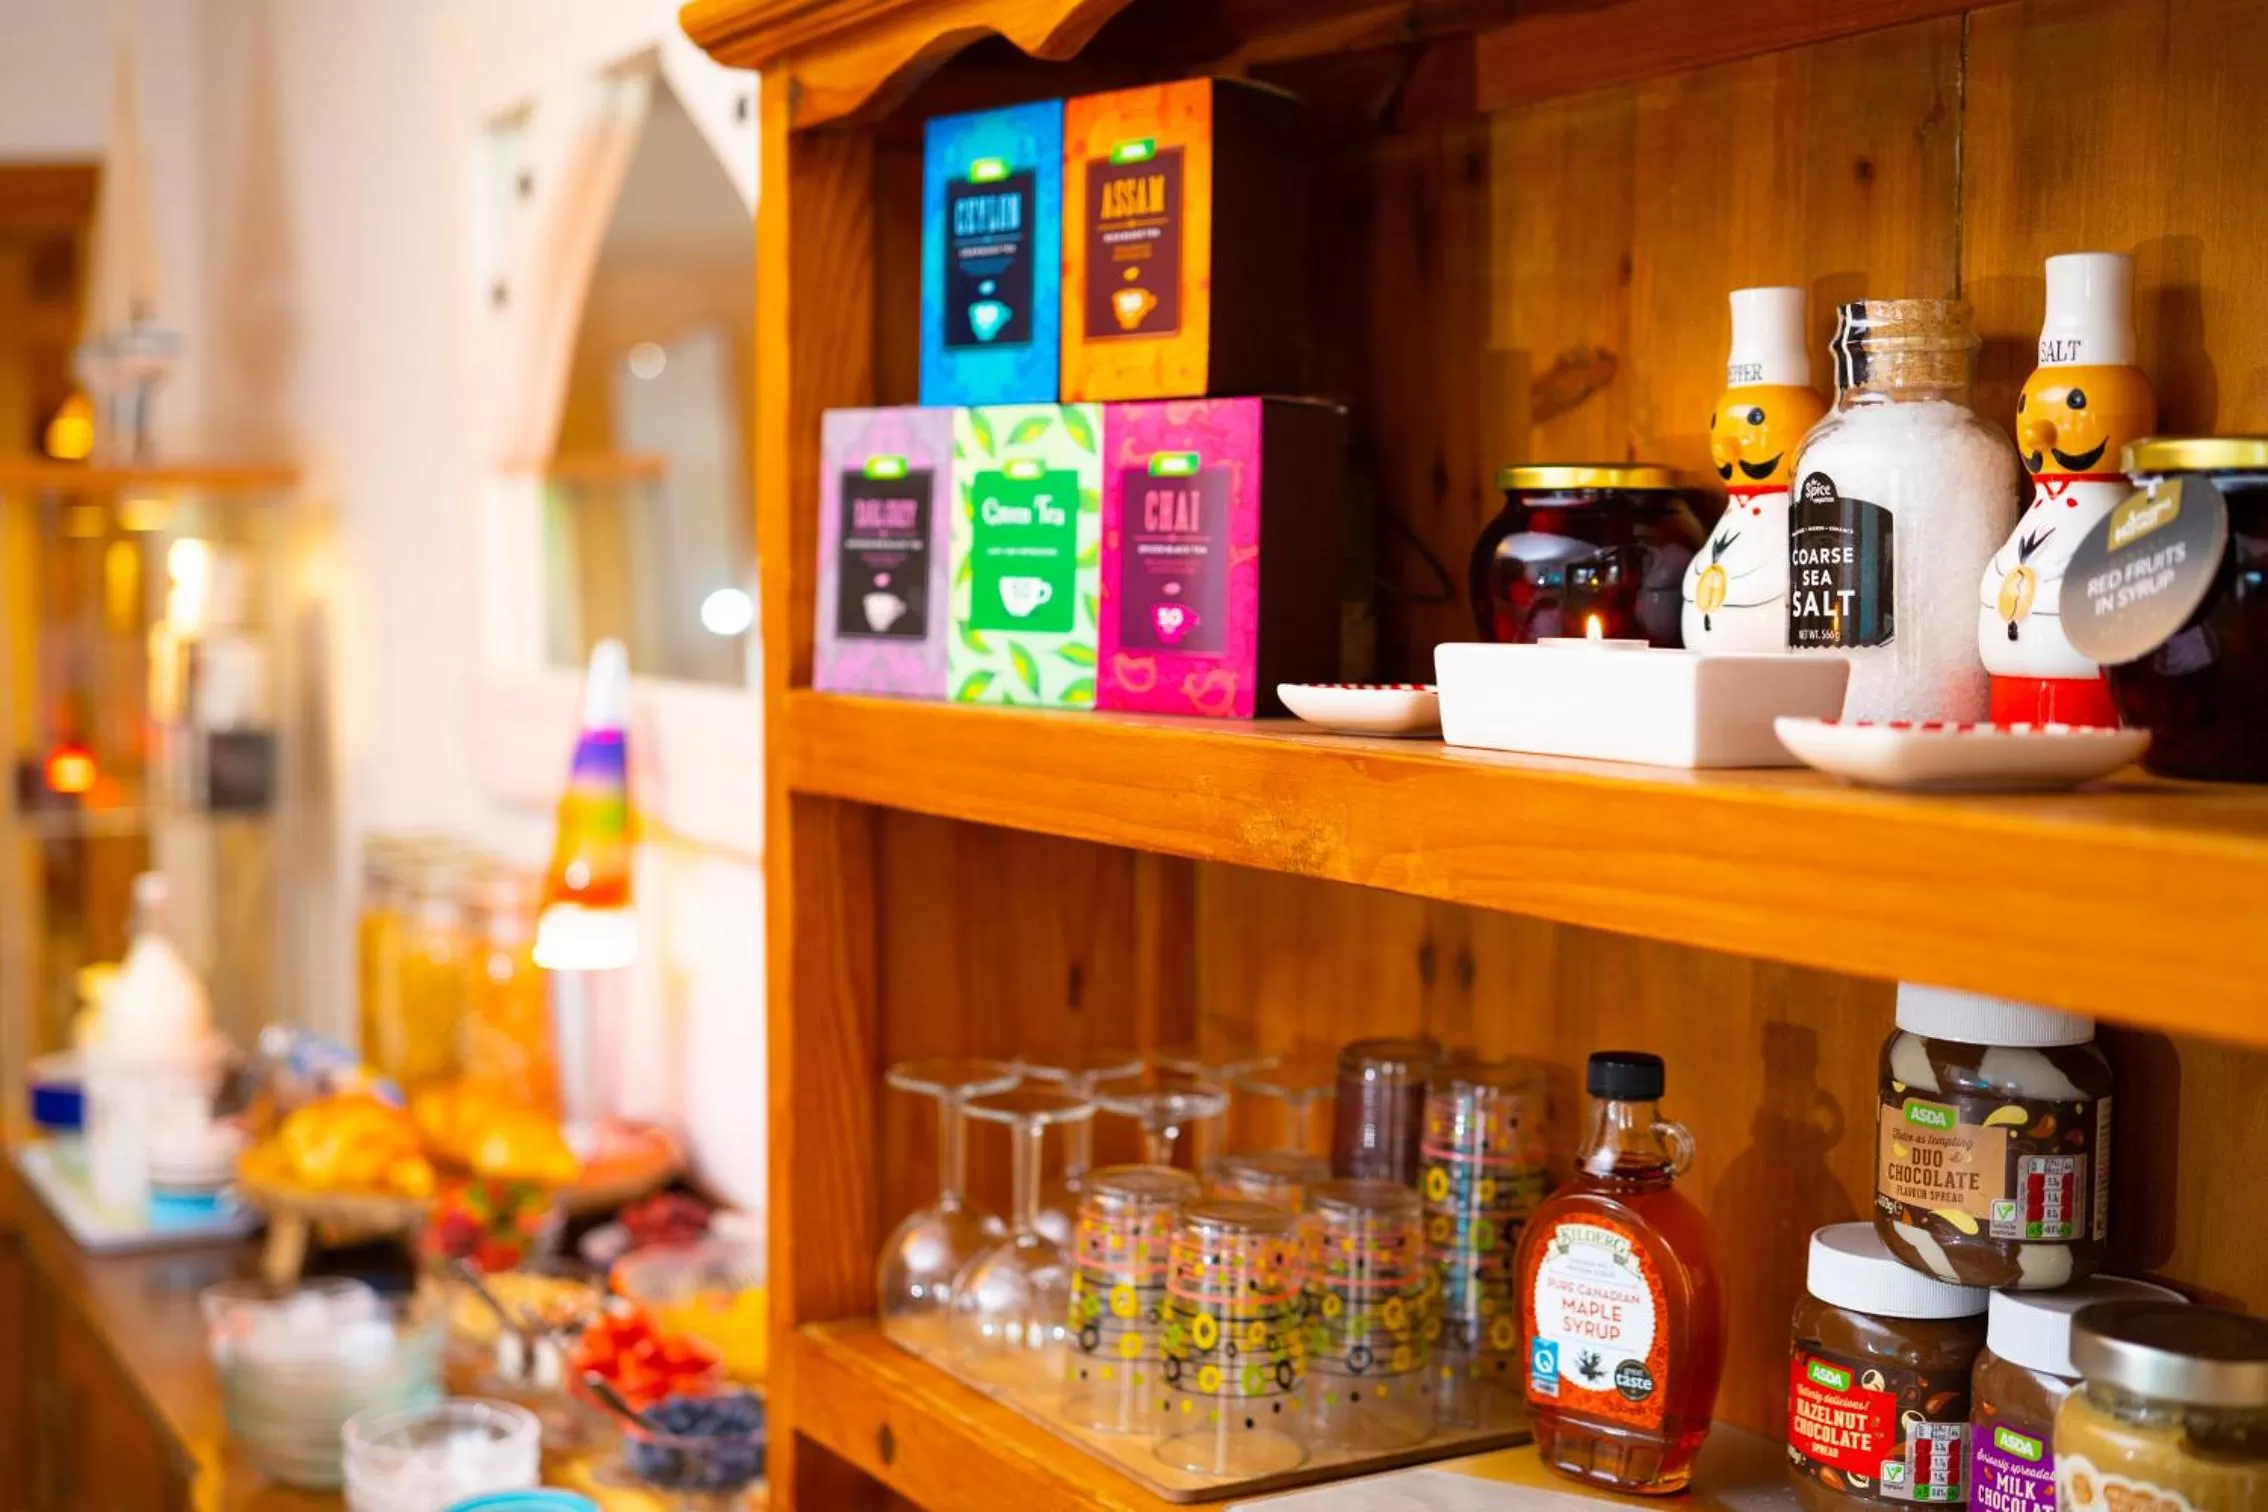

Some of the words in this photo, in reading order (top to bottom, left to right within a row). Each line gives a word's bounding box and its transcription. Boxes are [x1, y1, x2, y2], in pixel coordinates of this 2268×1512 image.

[1101, 174, 1165, 219] ASSAM
[1805, 482, 1831, 500] Spice
[981, 496, 1032, 527] Green
[1033, 494, 1065, 527] Tea
[1144, 489, 1200, 533] CHAI
[1792, 547, 1854, 566] COARSE
[2086, 568, 2123, 598] RED
[2124, 542, 2187, 584] FRUITS
[1803, 569, 1832, 586] SEA
[1792, 590, 1856, 618] SALT
[2095, 594, 2114, 616] IN
[2117, 568, 2175, 609] SYRUP
[1910, 1106, 1948, 1127] ASDA
[1911, 1147, 1943, 1168] DUO
[1887, 1162, 1981, 1191] CHOCOLATE
[1930, 1190, 1965, 1204] SPREAD
[1562, 1299, 1623, 1323] MAPLE
[1563, 1315, 1622, 1341] SYRUP
[1812, 1364, 1844, 1388] ASDA
[1797, 1397, 1869, 1432] HAZELNUT
[1794, 1415, 1872, 1452] CHOCOLATE
[2000, 1431, 2034, 1458] ASDA
[1996, 1471, 2037, 1501] MILK
